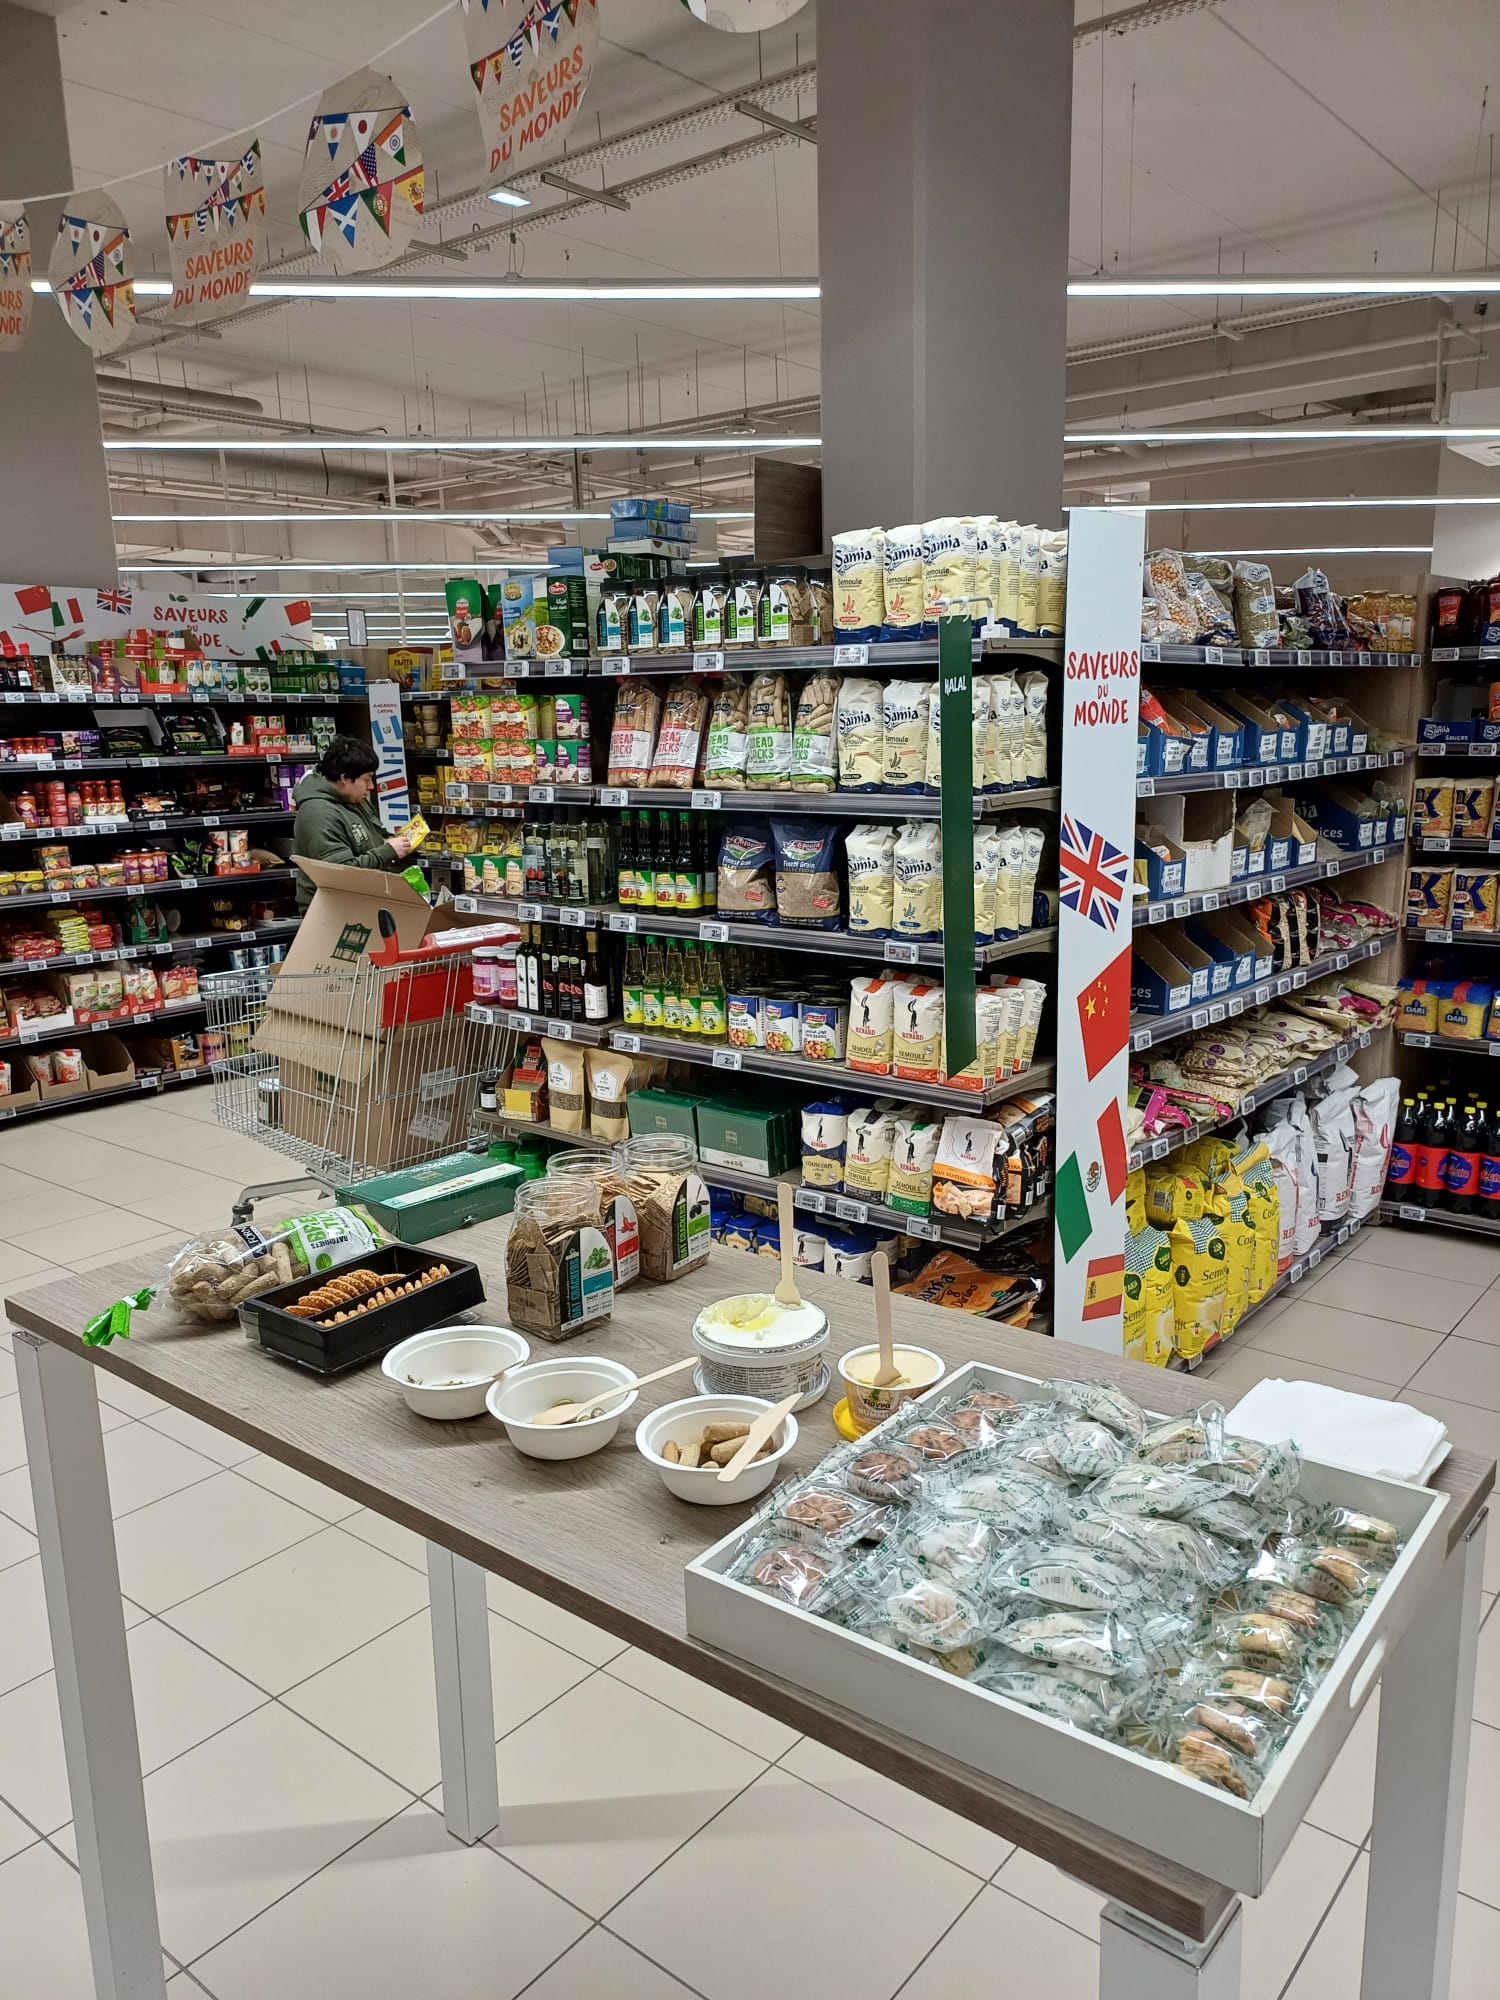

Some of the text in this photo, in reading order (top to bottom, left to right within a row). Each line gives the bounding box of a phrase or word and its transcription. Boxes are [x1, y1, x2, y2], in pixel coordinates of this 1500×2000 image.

[500, 44, 583, 132] SAVEURS
[490, 135, 512, 173] DU
[185, 239, 254, 280] SAVEURS
[174, 270, 250, 309] DU MONDE
[0, 291, 23, 310] URS
[0, 316, 22, 335] NDE
[884, 544, 922, 566] Samia
[922, 535, 961, 560] Samia
[835, 547, 872, 568] Samia
[153, 606, 228, 624] SAVEURS
[187, 624, 198, 632] DU
[193, 632, 222, 647] NDE
[1067, 650, 1138, 680] SAVEURS
[944, 675, 967, 695] HALAL
[1097, 684, 1108, 699] DU
[884, 706, 919, 725] Samia
[1074, 698, 1128, 727] MONDE
[839, 711, 872, 730] Samia
[660, 731, 681, 742] READ
[795, 738, 810, 748] EAD
[895, 859, 932, 878] Samia
[850, 885, 869, 893] emoule
[1130, 987, 1152, 998] ces
[1406, 1006, 1425, 1014] DARI
[1447, 1015, 1466, 1023] DARI
[855, 1027, 876, 1035] RENARD
[902, 1032, 924, 1040] RENARD
[851, 1044, 877, 1054] SEMOULE
[898, 1050, 926, 1060] SEMOULE
[804, 1160, 833, 1169] COUSCOUS
[851, 1154, 870, 1162] RENARD
[900, 1163, 920, 1172] RENARD
[895, 1180, 920, 1191] SEMOULE
[1336, 1188, 1350, 1202] REN
[1308, 1215, 1320, 1228] REN
[676, 1200, 689, 1259] OAT CRACKERS
[1283, 1227, 1296, 1240] REN
[310, 1235, 349, 1249] BATONNETS
[1201, 1266, 1226, 1281] Semo
[569, 1257, 583, 1320] OAT CRACKERS
[917, 1273, 956, 1302] amia
